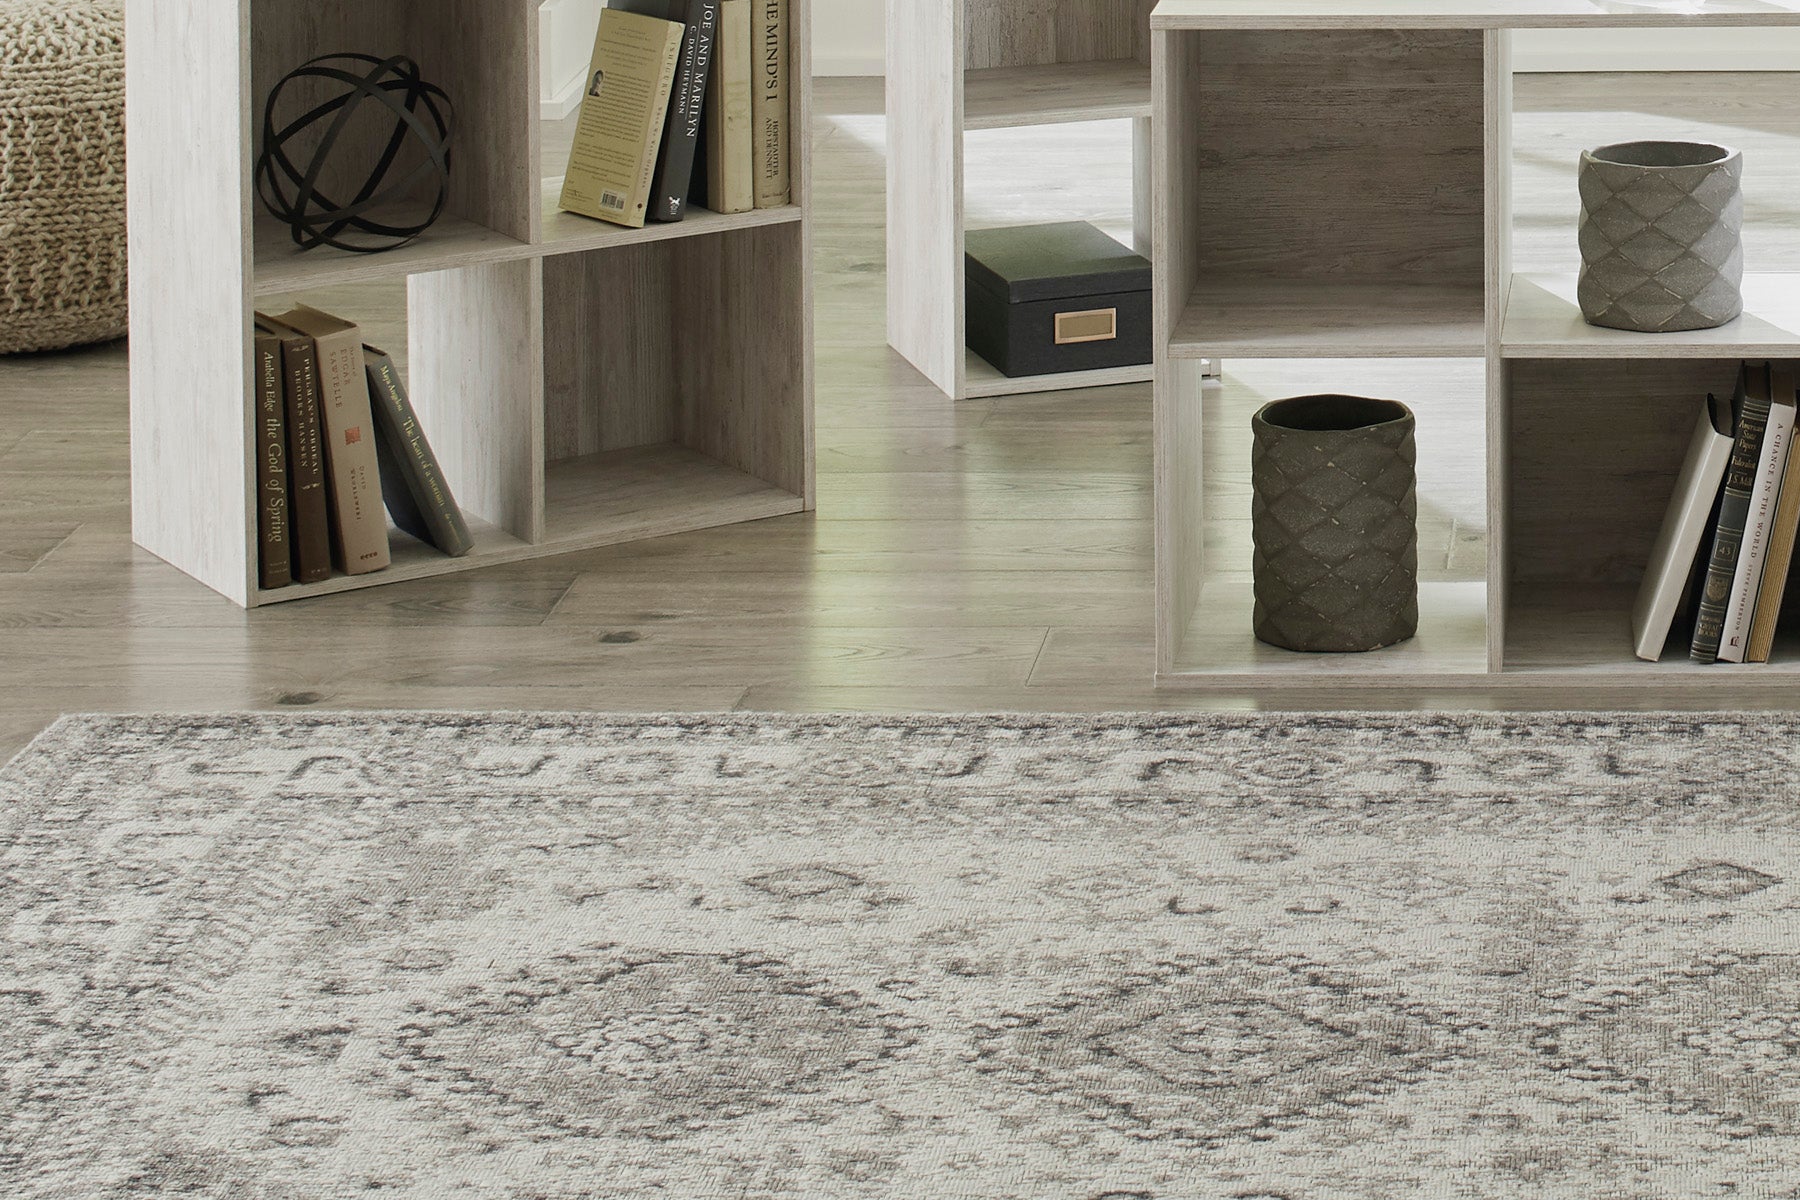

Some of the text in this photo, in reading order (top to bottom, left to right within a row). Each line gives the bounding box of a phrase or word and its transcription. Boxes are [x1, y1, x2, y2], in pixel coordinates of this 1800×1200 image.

[660, 42, 677, 97] ISHIGURO
[678, 25, 698, 114] C. DAVID HEYMANN
[686, 3, 715, 137] JOE AND MARILYN
[765, 24, 778, 90] MIND'S
[765, 117, 773, 179] AND DENNETT
[772, 120, 780, 177] HOFSTADTER
[264, 351, 276, 412] Arabella Edge
[330, 351, 343, 408] SAWTELLE
[340, 349, 351, 386] EDGAR
[267, 418, 281, 439] the
[1738, 419, 1764, 432] American
[1739, 440, 1757, 452] Papers
[1743, 429, 1757, 440] State
[267, 443, 284, 473] God
[403, 415, 415, 437] The
[411, 435, 425, 460] heart
[421, 457, 434, 469] of
[429, 474, 445, 506] woman
[1767, 434, 1782, 476] CHANCE
[265, 479, 285, 494] of
[1759, 496, 1769, 517] THE
[1764, 480, 1772, 492] IN
[267, 497, 285, 542] Spring
[1750, 521, 1764, 559] WORLD
[1719, 547, 1731, 556] 43
[1735, 587, 1749, 631] PEMBERTON
